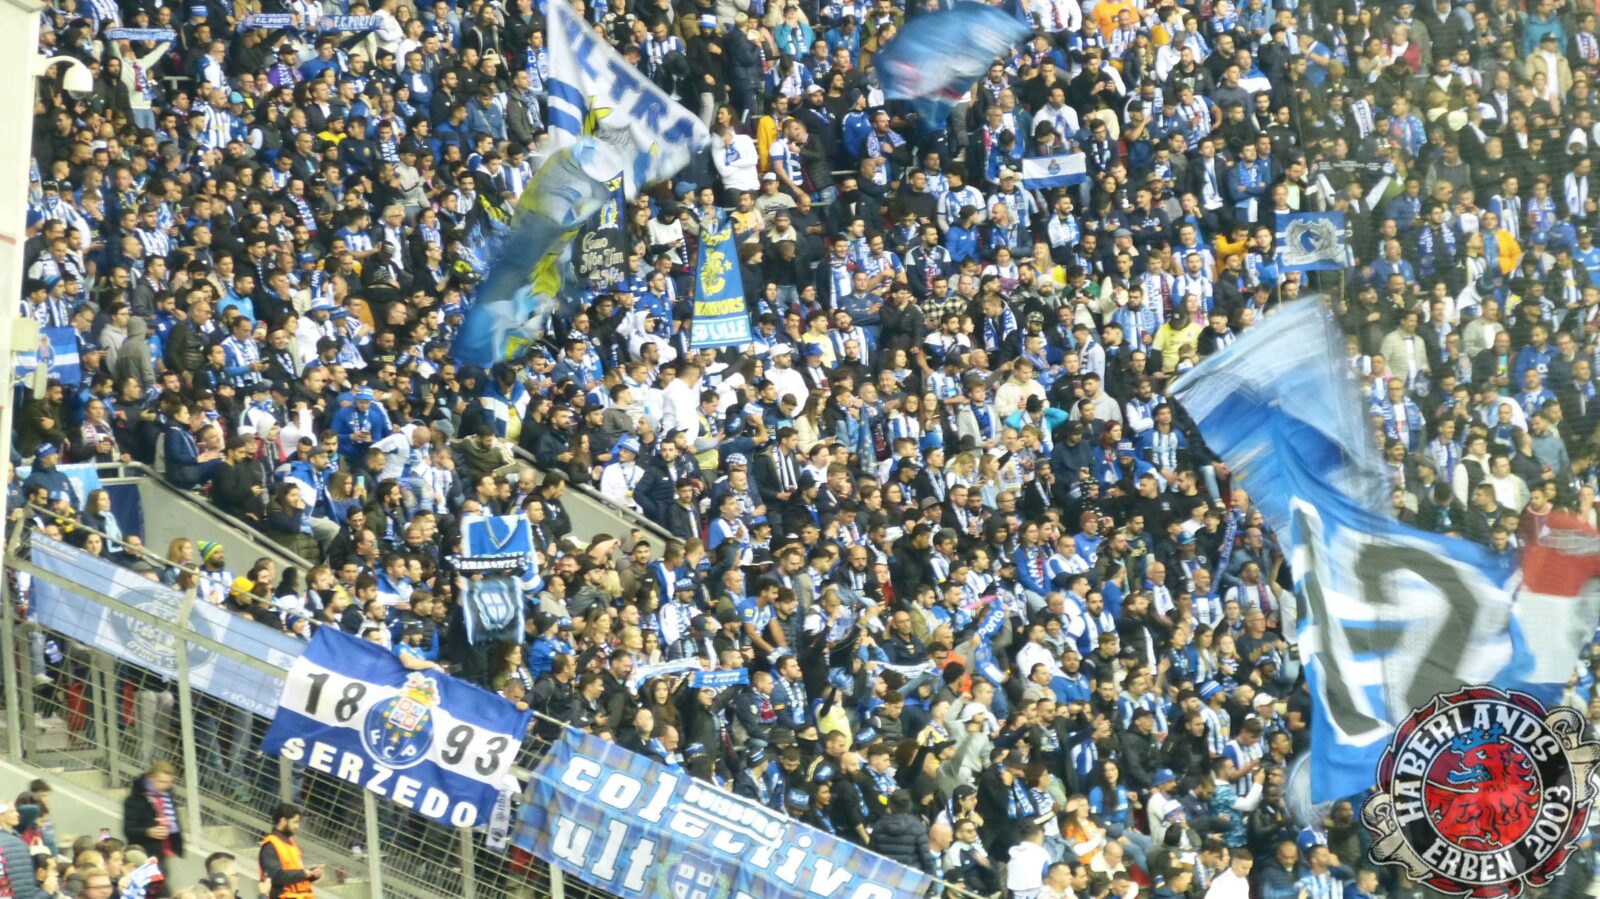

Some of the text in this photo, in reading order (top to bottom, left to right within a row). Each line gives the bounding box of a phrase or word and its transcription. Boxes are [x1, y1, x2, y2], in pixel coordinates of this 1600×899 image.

[461, 559, 518, 570] AMARANTE
[305, 673, 367, 723] 18
[440, 725, 509, 776] 93
[280, 737, 478, 828] SERZEDO
